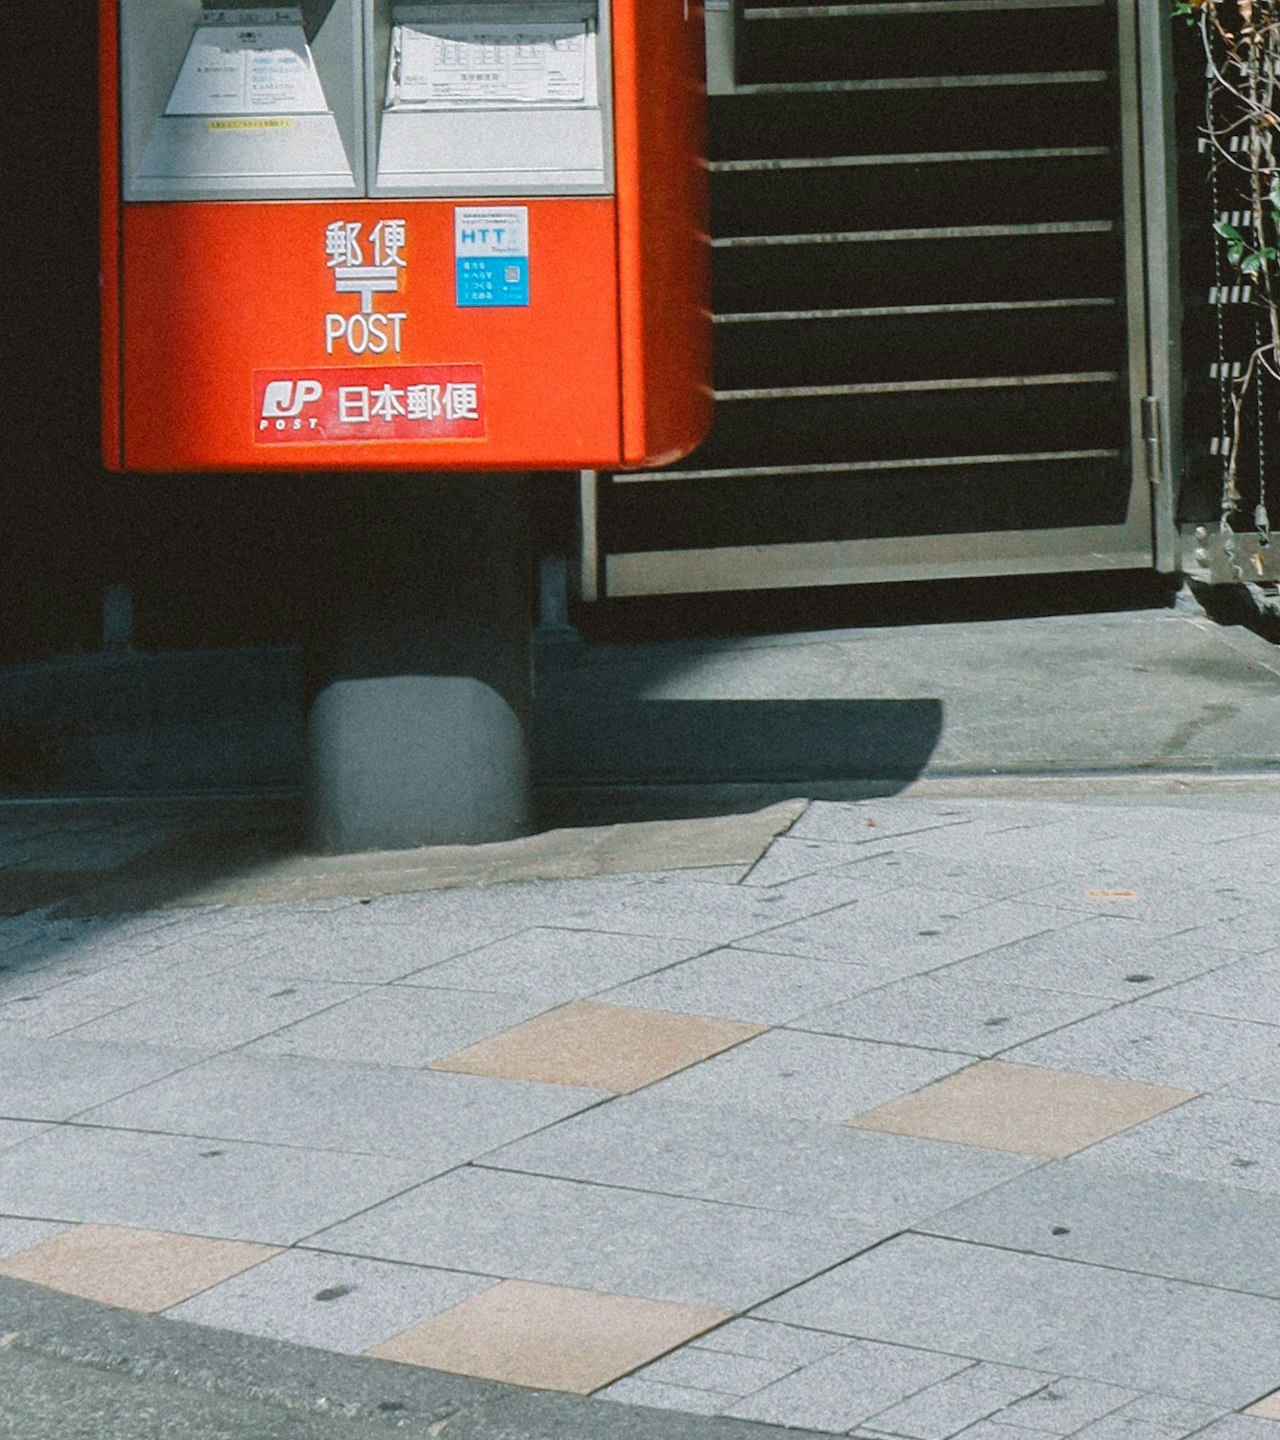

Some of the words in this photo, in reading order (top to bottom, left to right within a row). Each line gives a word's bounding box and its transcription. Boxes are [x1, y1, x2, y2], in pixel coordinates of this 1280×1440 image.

[324, 218, 407, 267] 郵便
[461, 228, 505, 244] HTT
[325, 312, 406, 355] POST
[338, 383, 480, 423] 日本郵便
[258, 418, 320, 431] POST
